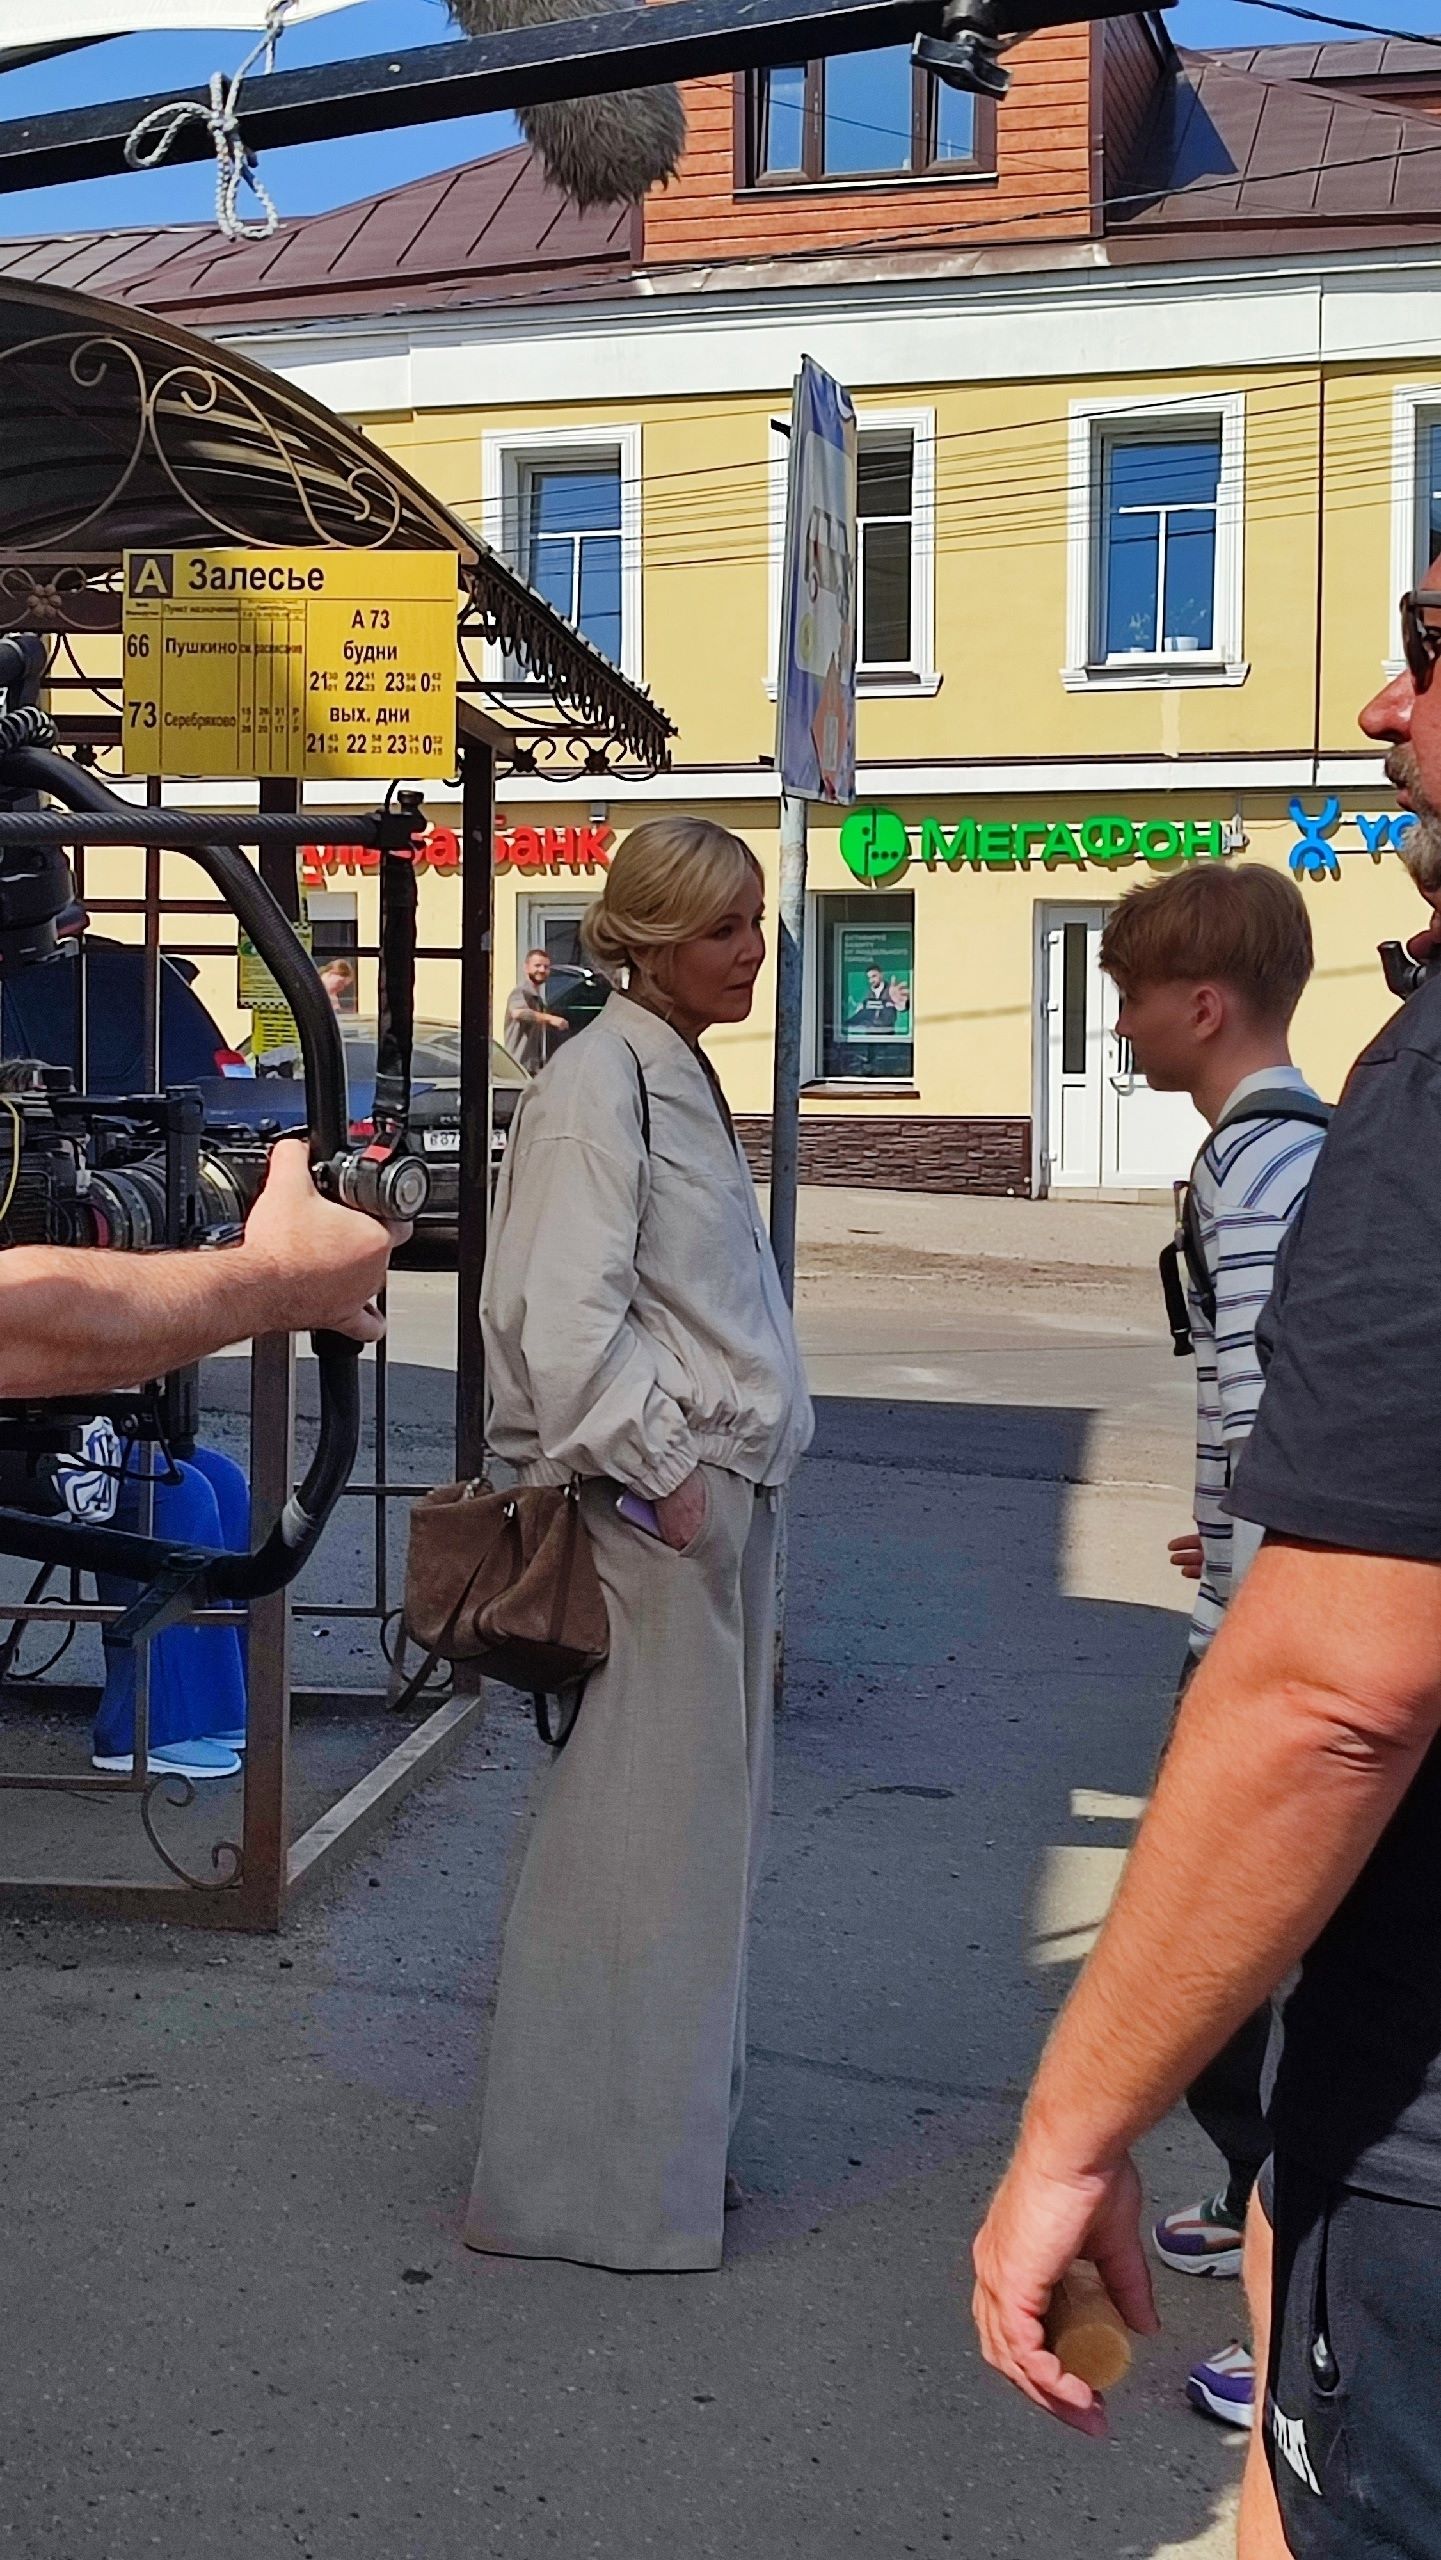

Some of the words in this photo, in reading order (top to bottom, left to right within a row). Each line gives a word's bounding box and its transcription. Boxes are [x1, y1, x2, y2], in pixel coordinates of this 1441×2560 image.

[134, 558, 167, 594] А
[188, 558, 325, 591] Залесье
[352, 609, 365, 628] А
[370, 609, 390, 629] 73
[127, 633, 150, 658] 66
[165, 637, 238, 658] Пушкино
[343, 640, 398, 665] будни
[310, 671, 328, 692] 21
[345, 671, 365, 692] 22
[385, 672, 405, 692] 23
[420, 672, 430, 692] 0
[128, 702, 157, 728] 73
[164, 712, 236, 730] Серебряково
[330, 708, 371, 722] вых.
[376, 708, 410, 726] дни
[307, 733, 324, 754] 21
[346, 734, 367, 754] 22
[387, 734, 407, 754] 23
[423, 735, 432, 754] 0
[920, 815, 1223, 862] МЕГАФОН
